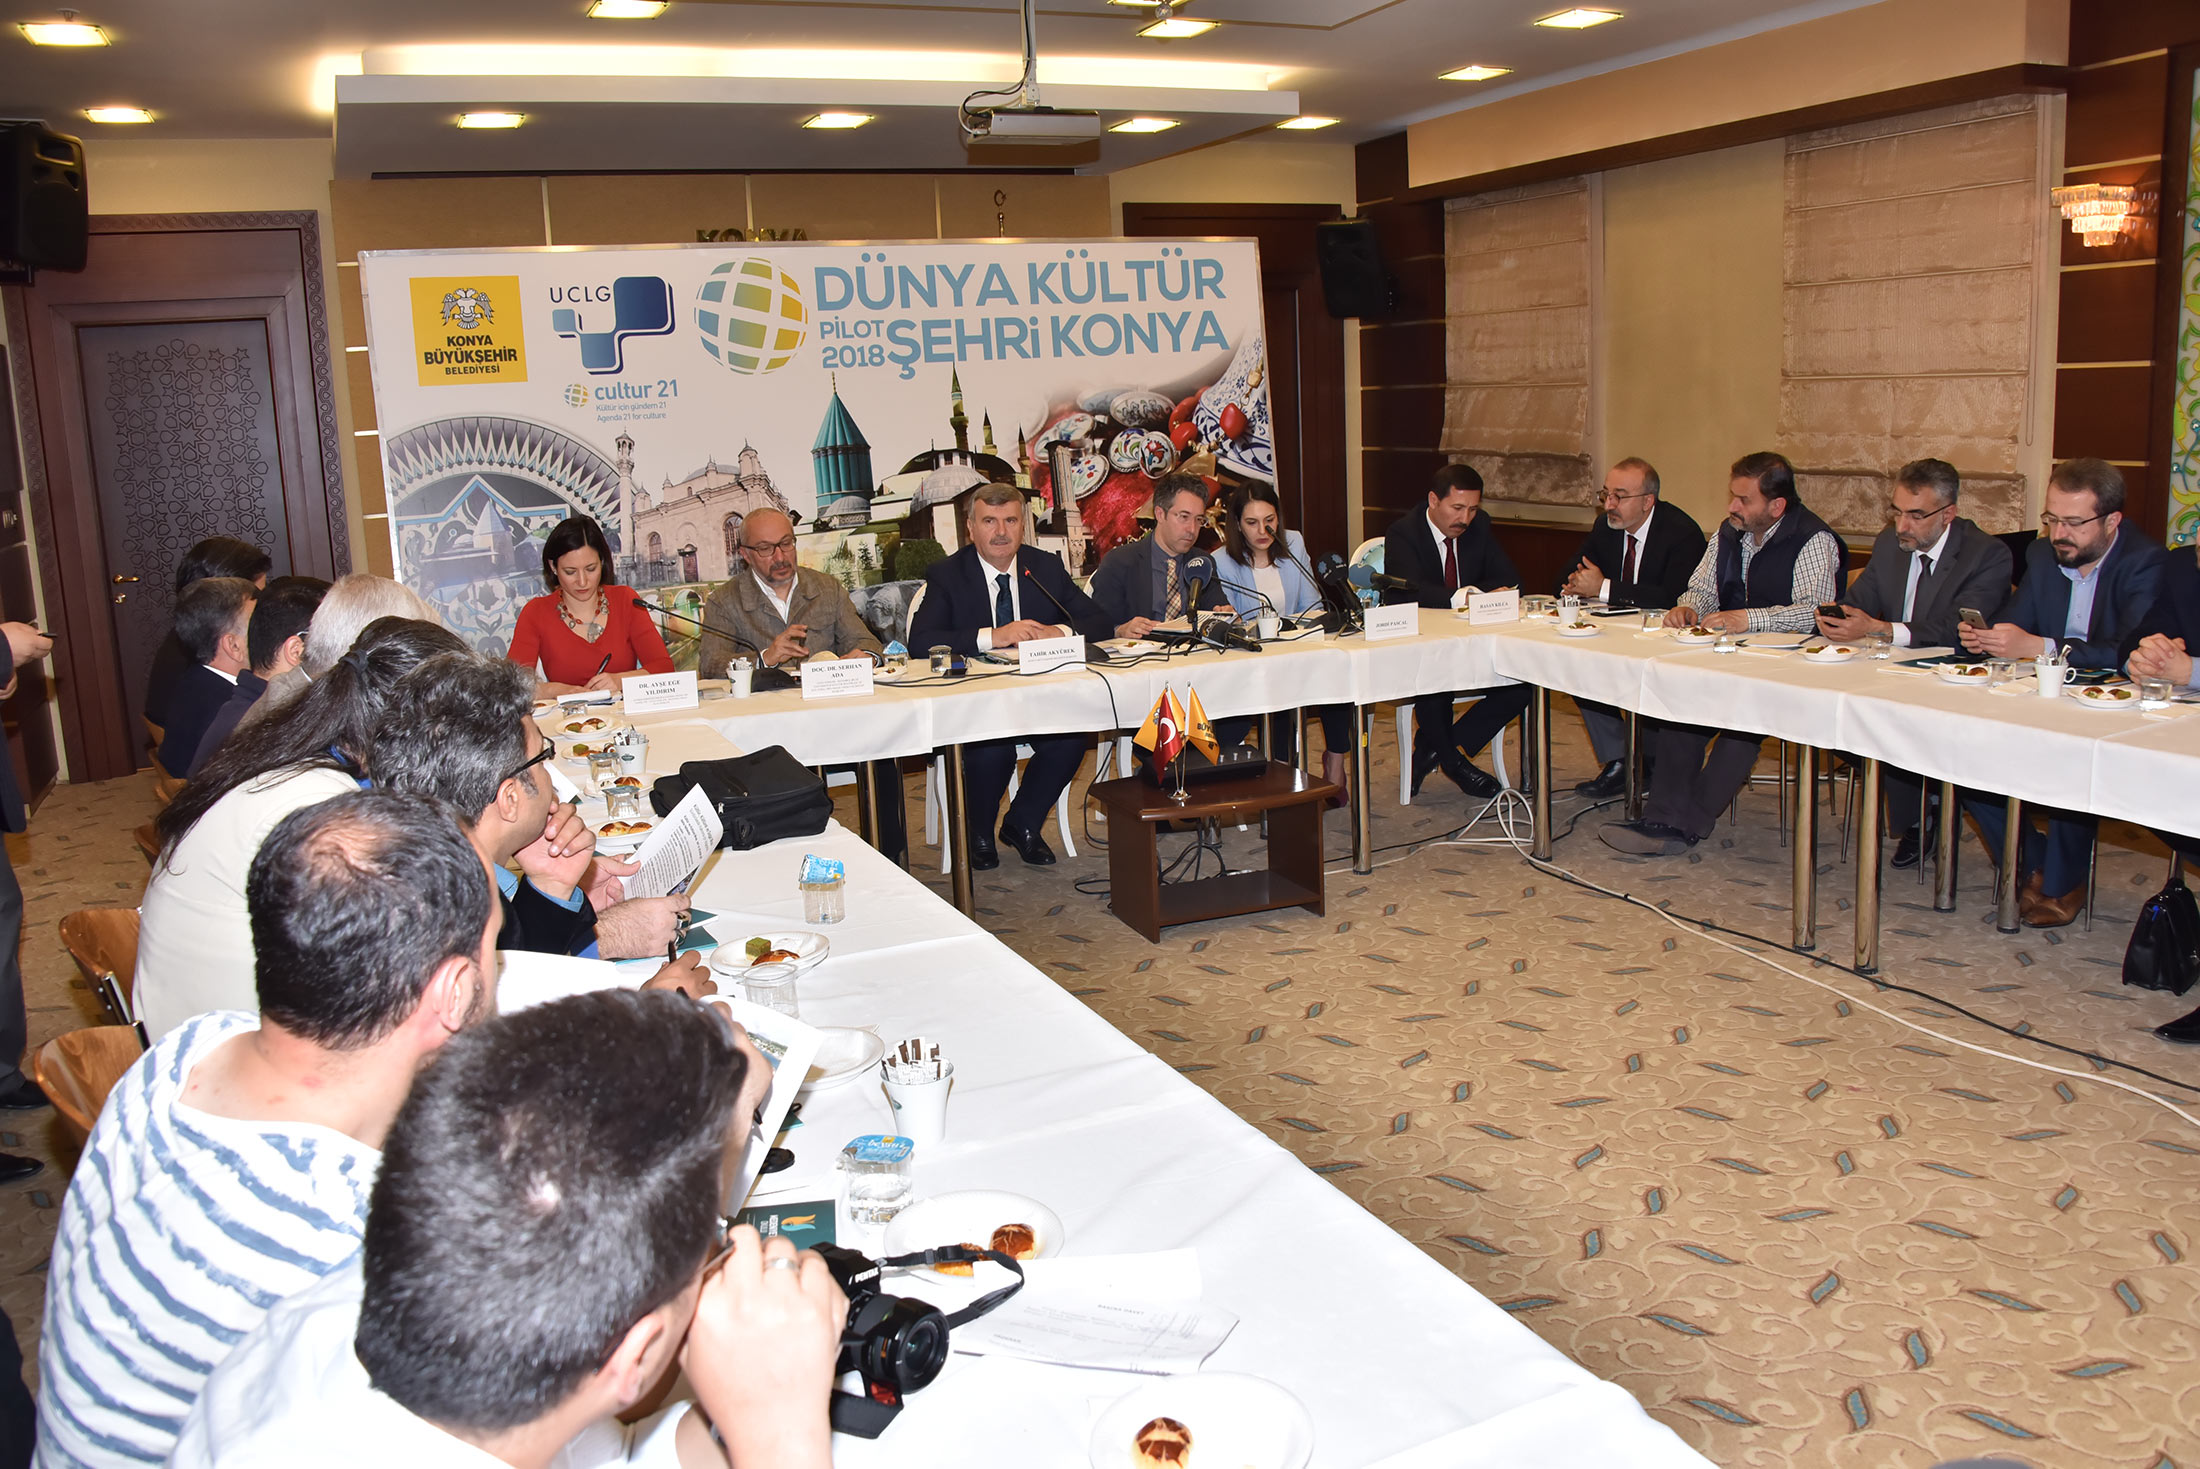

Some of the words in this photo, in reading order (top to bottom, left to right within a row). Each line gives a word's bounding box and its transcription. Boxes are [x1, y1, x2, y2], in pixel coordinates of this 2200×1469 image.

[814, 252, 1019, 311] DÜNYA
[1028, 247, 1227, 305] KÜLTÜR
[550, 286, 611, 303] UCLG
[446, 335, 493, 347] KONYA
[1050, 310, 1230, 358] KONYA
[424, 346, 518, 365] BÜYÜKŞEHİR
[822, 344, 885, 368] 2018
[445, 363, 500, 375] BELEDİYESİ
[594, 381, 653, 400] cultur
[657, 379, 678, 397] 21
[596, 403, 617, 411] Kültür
[618, 403, 630, 411] için
[631, 402, 658, 411] gündem
[658, 401, 667, 409] 21
[597, 414, 622, 423] Agenda
[632, 412, 641, 420] for
[642, 412, 667, 420] culture
[855, 1266, 879, 1283] PENTAX
